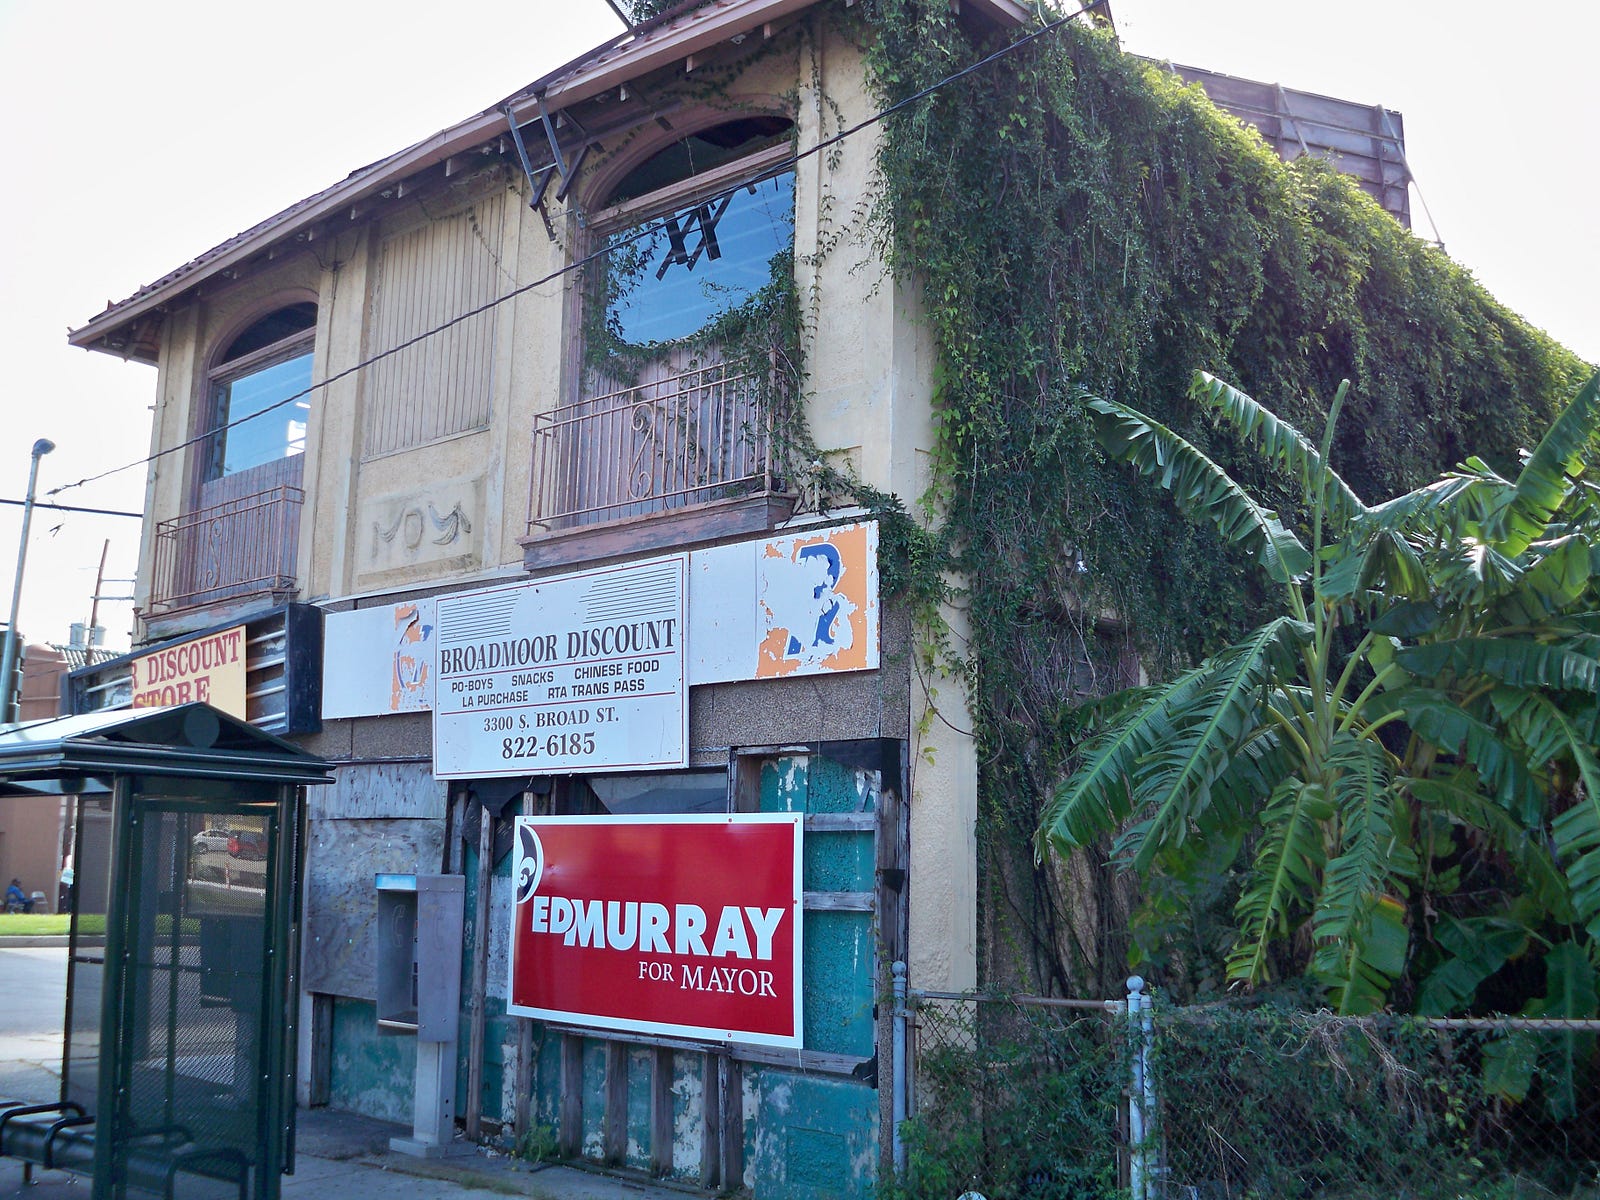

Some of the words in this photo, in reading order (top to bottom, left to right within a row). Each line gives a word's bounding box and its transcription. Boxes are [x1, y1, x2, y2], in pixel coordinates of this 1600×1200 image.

[147, 630, 241, 685] DISCOUNT
[440, 634, 558, 675] BROADMOOR
[567, 618, 676, 659] DISCOUNT
[132, 676, 211, 708] STORE
[451, 678, 494, 693] PO-BOYS
[511, 671, 554, 687] SNACKS
[574, 663, 623, 680] CHINESE
[627, 659, 660, 675] FOOD
[462, 697, 475, 708] LA
[477, 690, 529, 706] PURCHASE
[547, 686, 567, 700] RTA
[572, 682, 609, 696] TRANS
[614, 678, 645, 693] PASS
[483, 715, 513, 732] 3300
[518, 713, 530, 729] S.
[536, 709, 590, 728] BROAD
[595, 706, 619, 723] ST.
[502, 731, 596, 760] 822-6185
[638, 961, 674, 982] FOR
[680, 964, 777, 998] MAYOR
